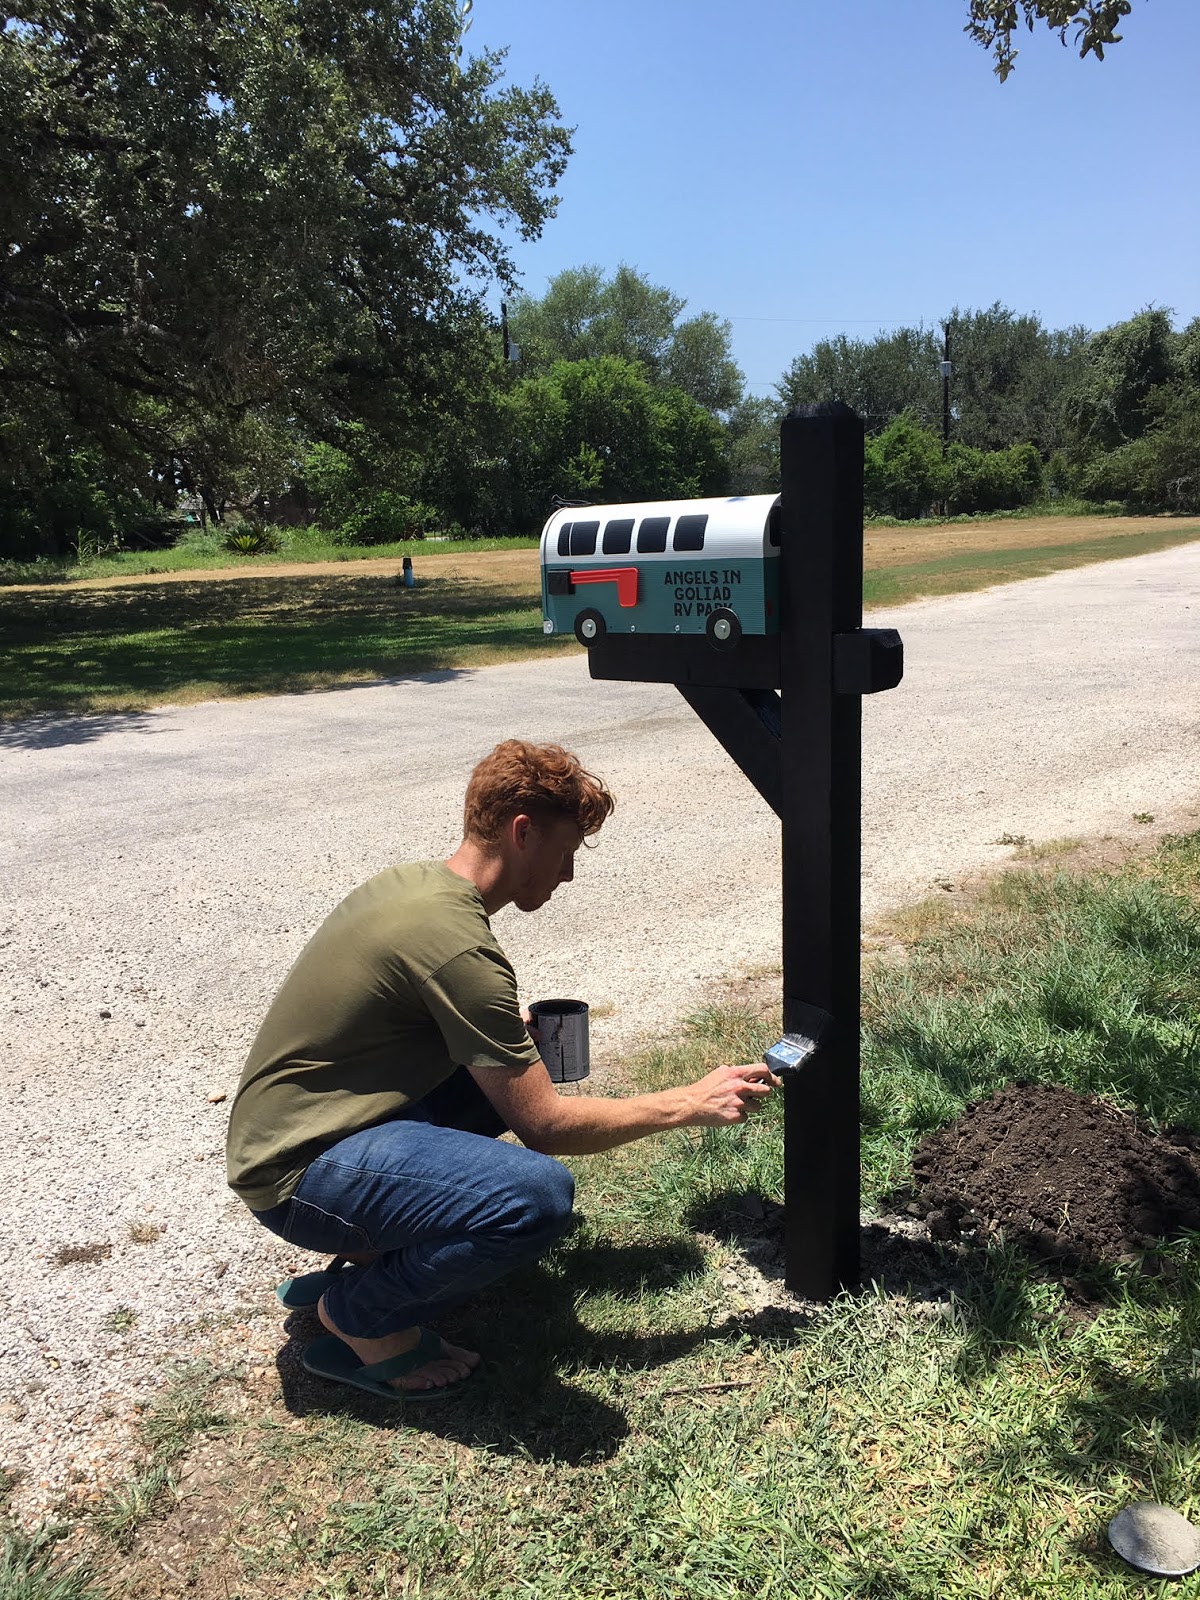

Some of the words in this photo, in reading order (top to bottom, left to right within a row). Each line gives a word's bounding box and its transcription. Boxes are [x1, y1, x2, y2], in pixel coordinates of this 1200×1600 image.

[664, 571, 718, 585] ANGELS
[722, 570, 741, 584] IN
[674, 587, 731, 600] GOLIAD
[674, 602, 692, 616] RV
